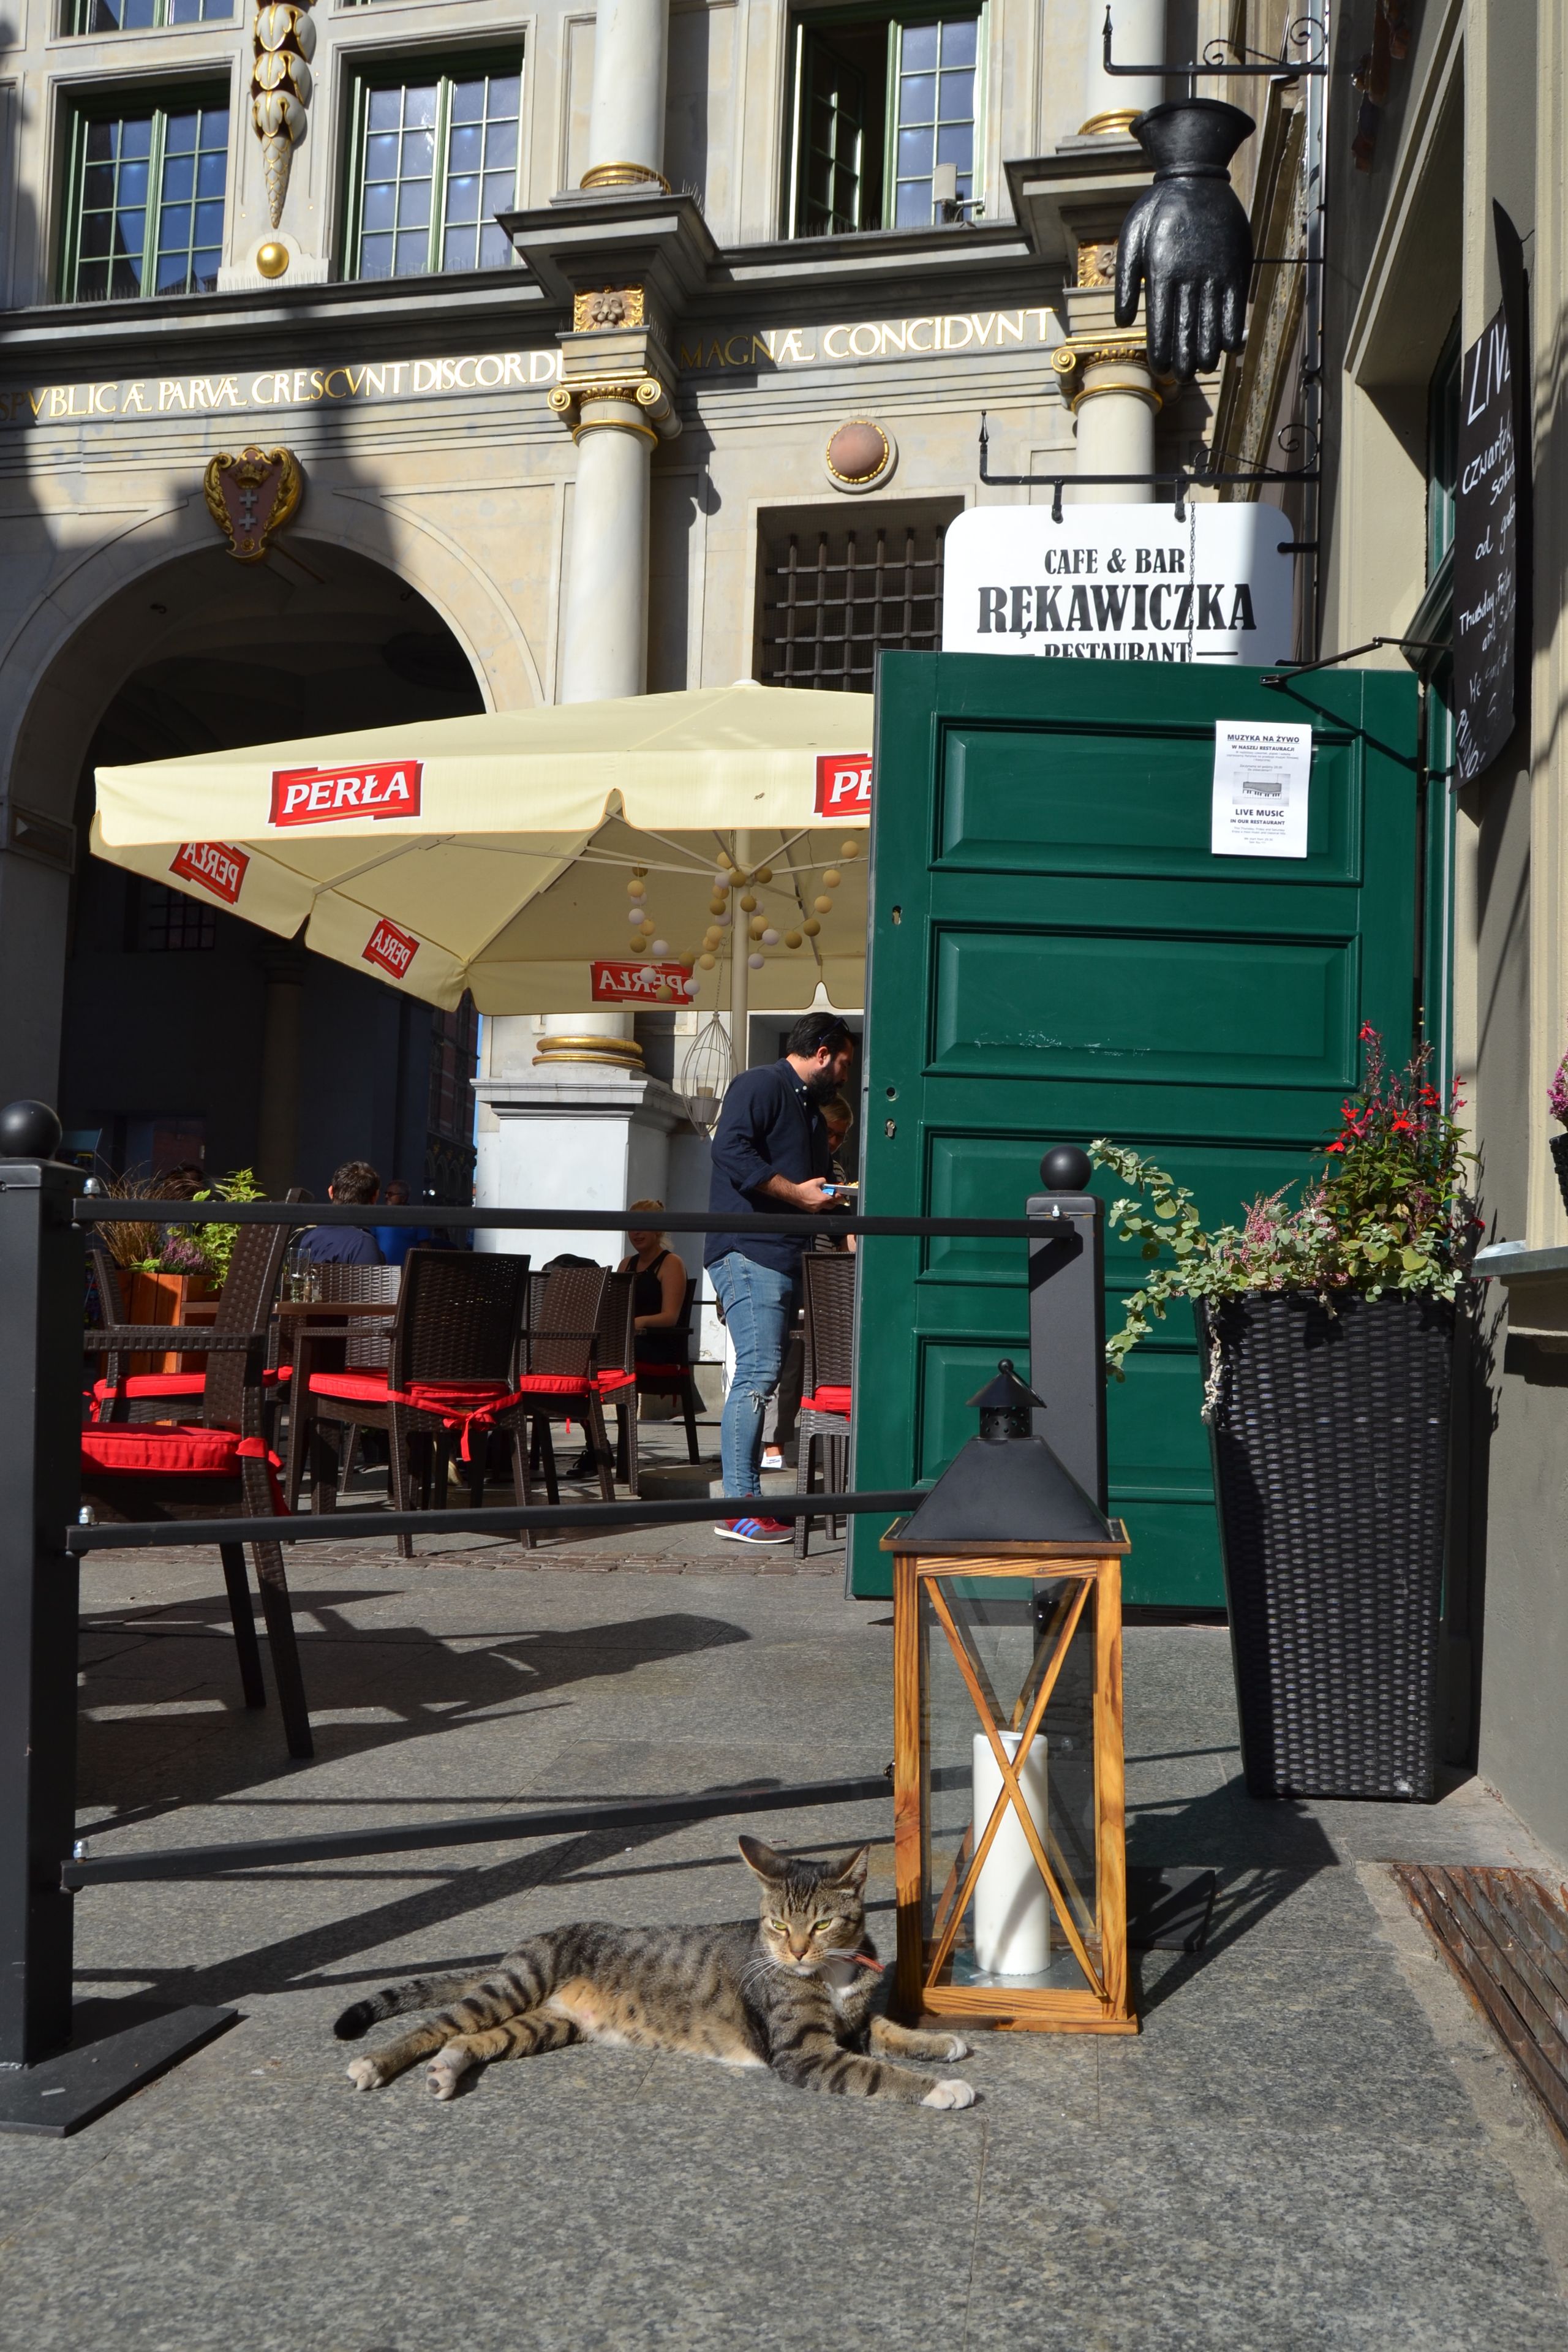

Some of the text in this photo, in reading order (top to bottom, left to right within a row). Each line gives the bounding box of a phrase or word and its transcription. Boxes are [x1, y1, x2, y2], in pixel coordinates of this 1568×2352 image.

[823, 307, 1057, 356] CONCIDVNT
[251, 362, 409, 404] CRESCVNT
[1044, 548, 1185, 575] CAFE & BAR
[1476, 525, 1493, 560] od
[976, 582, 1257, 638] RĘKAWICZKA
[282, 771, 410, 814] PERŁA
[829, 769, 872, 803] PE
